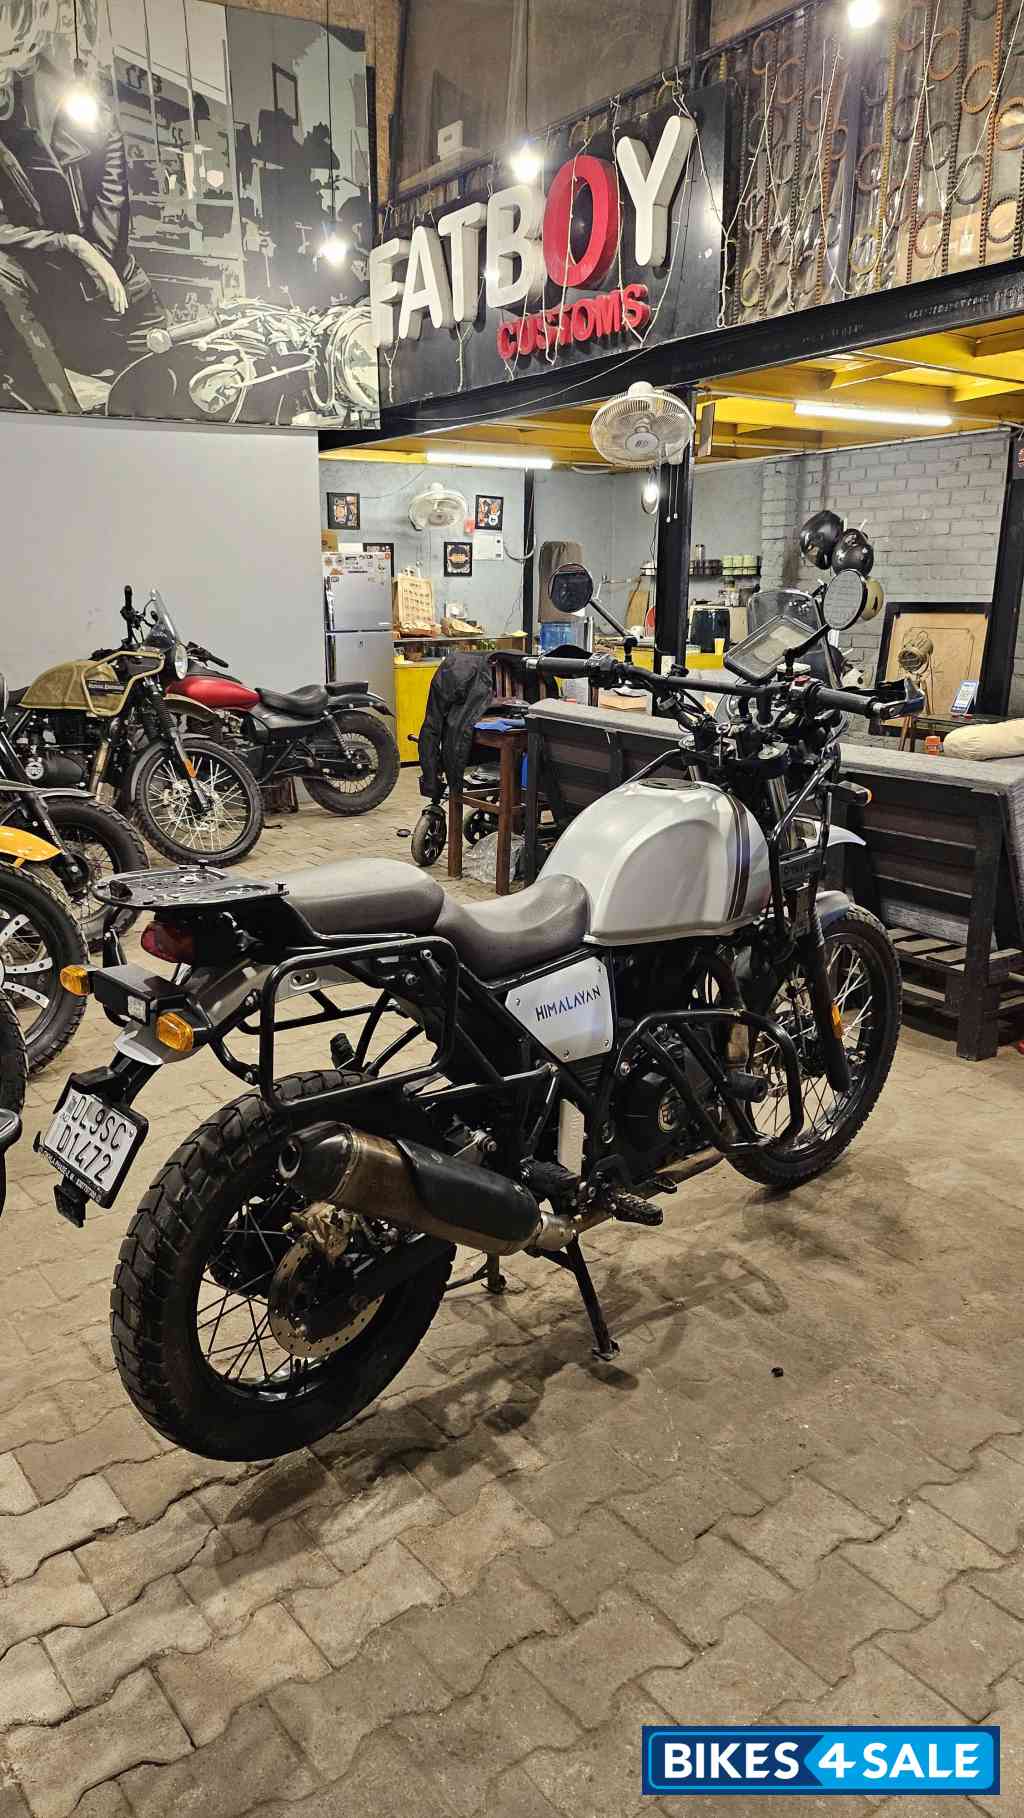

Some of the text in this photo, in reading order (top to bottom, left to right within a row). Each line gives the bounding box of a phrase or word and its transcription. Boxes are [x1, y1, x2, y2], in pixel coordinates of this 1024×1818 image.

[369, 115, 697, 346] FATBOY
[497, 283, 649, 360] CUSTOMS
[535, 985, 601, 1022] HIMALAYAN
